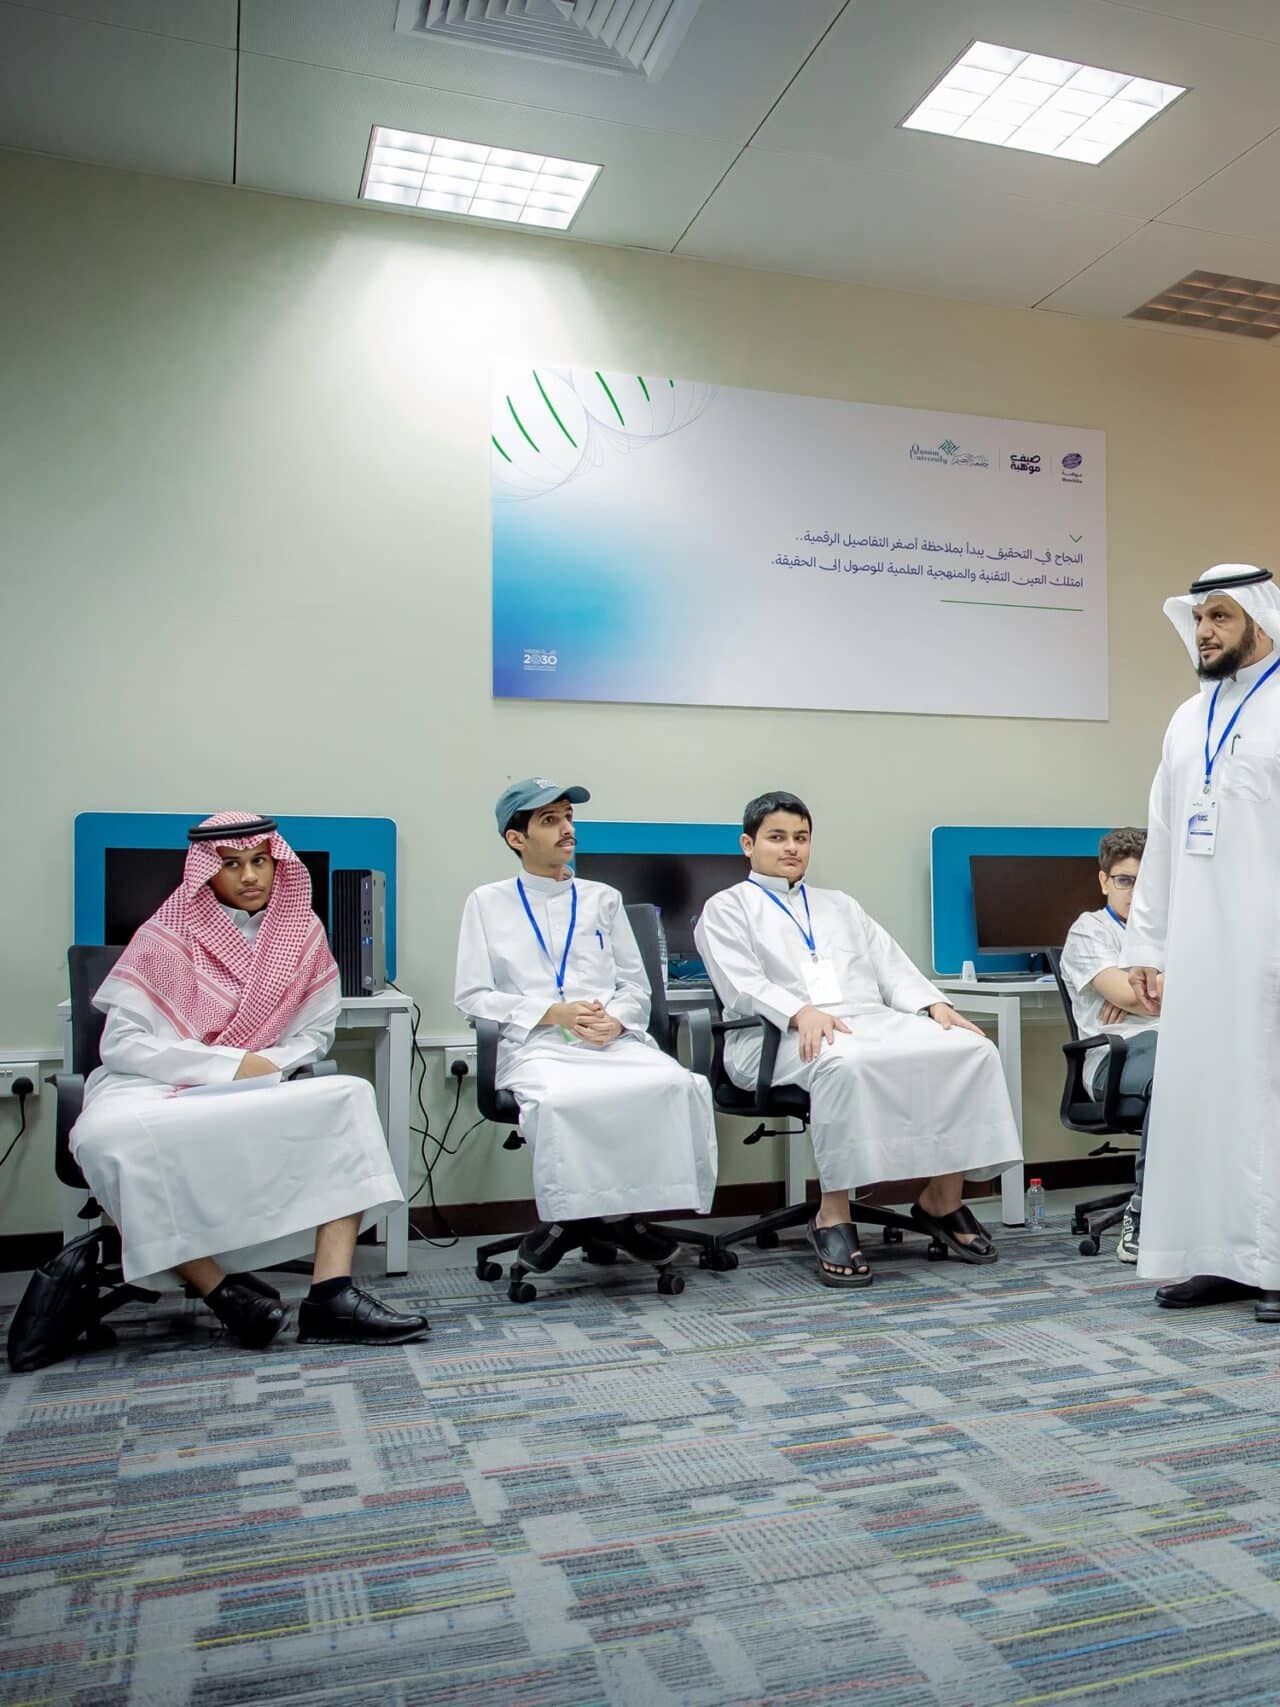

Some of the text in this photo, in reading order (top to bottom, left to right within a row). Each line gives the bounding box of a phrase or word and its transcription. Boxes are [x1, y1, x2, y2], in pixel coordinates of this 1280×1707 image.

[1010, 454, 1041, 464] صيف
[1010, 462, 1041, 475] موهبة
[842, 533, 889, 548] التفاصيل
[890, 537, 918, 551] أصغر
[921, 540, 964, 558] بملاحظة
[966, 541, 985, 559] يبدأ
[986, 549, 1033, 561] التحقيق
[1034, 547, 1051, 565] في
[1054, 553, 1083, 566] النجاح
[771, 553, 1084, 588] امتلك العين التقنية والمنهجية العلمية للوصول إلى الحقيقة.
[523, 654, 558, 665] 2030
